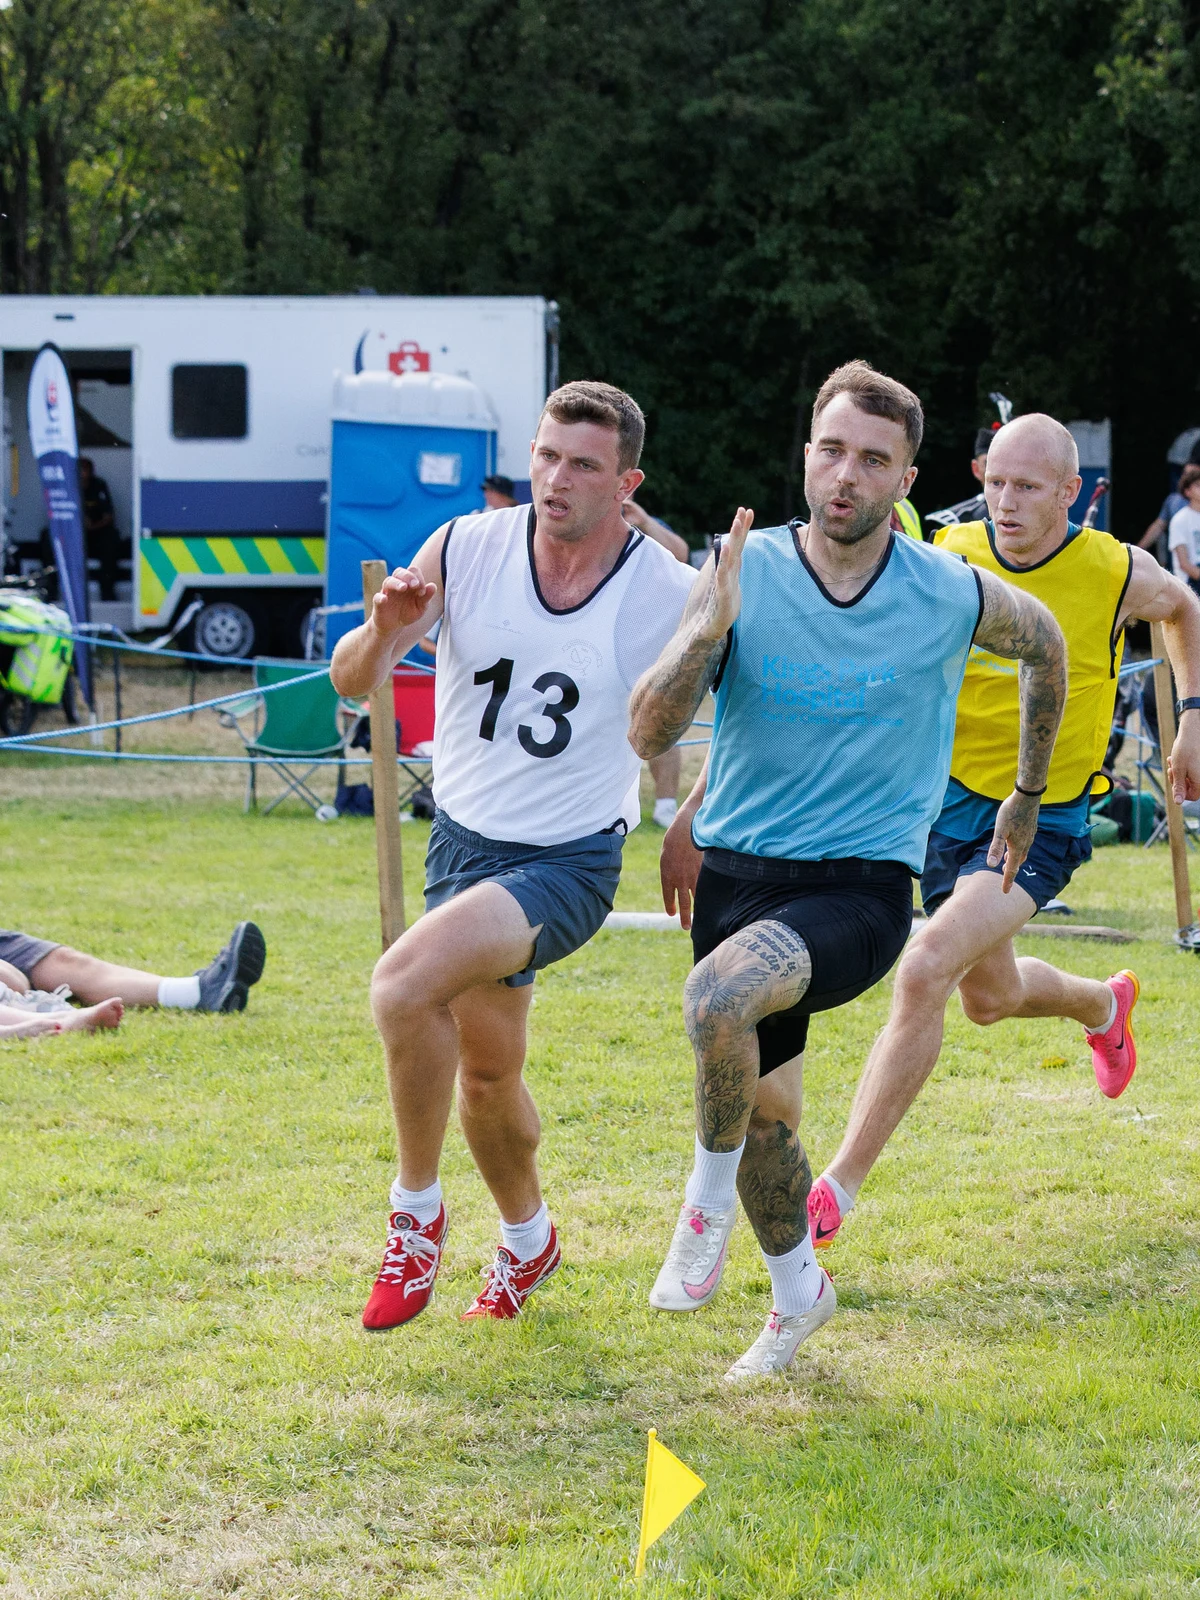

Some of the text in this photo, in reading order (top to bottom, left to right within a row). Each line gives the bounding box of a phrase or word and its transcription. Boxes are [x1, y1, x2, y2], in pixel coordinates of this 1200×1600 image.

[762, 654, 897, 685] Kings Park
[473, 657, 580, 759] 13
[761, 682, 865, 711] Hospital
